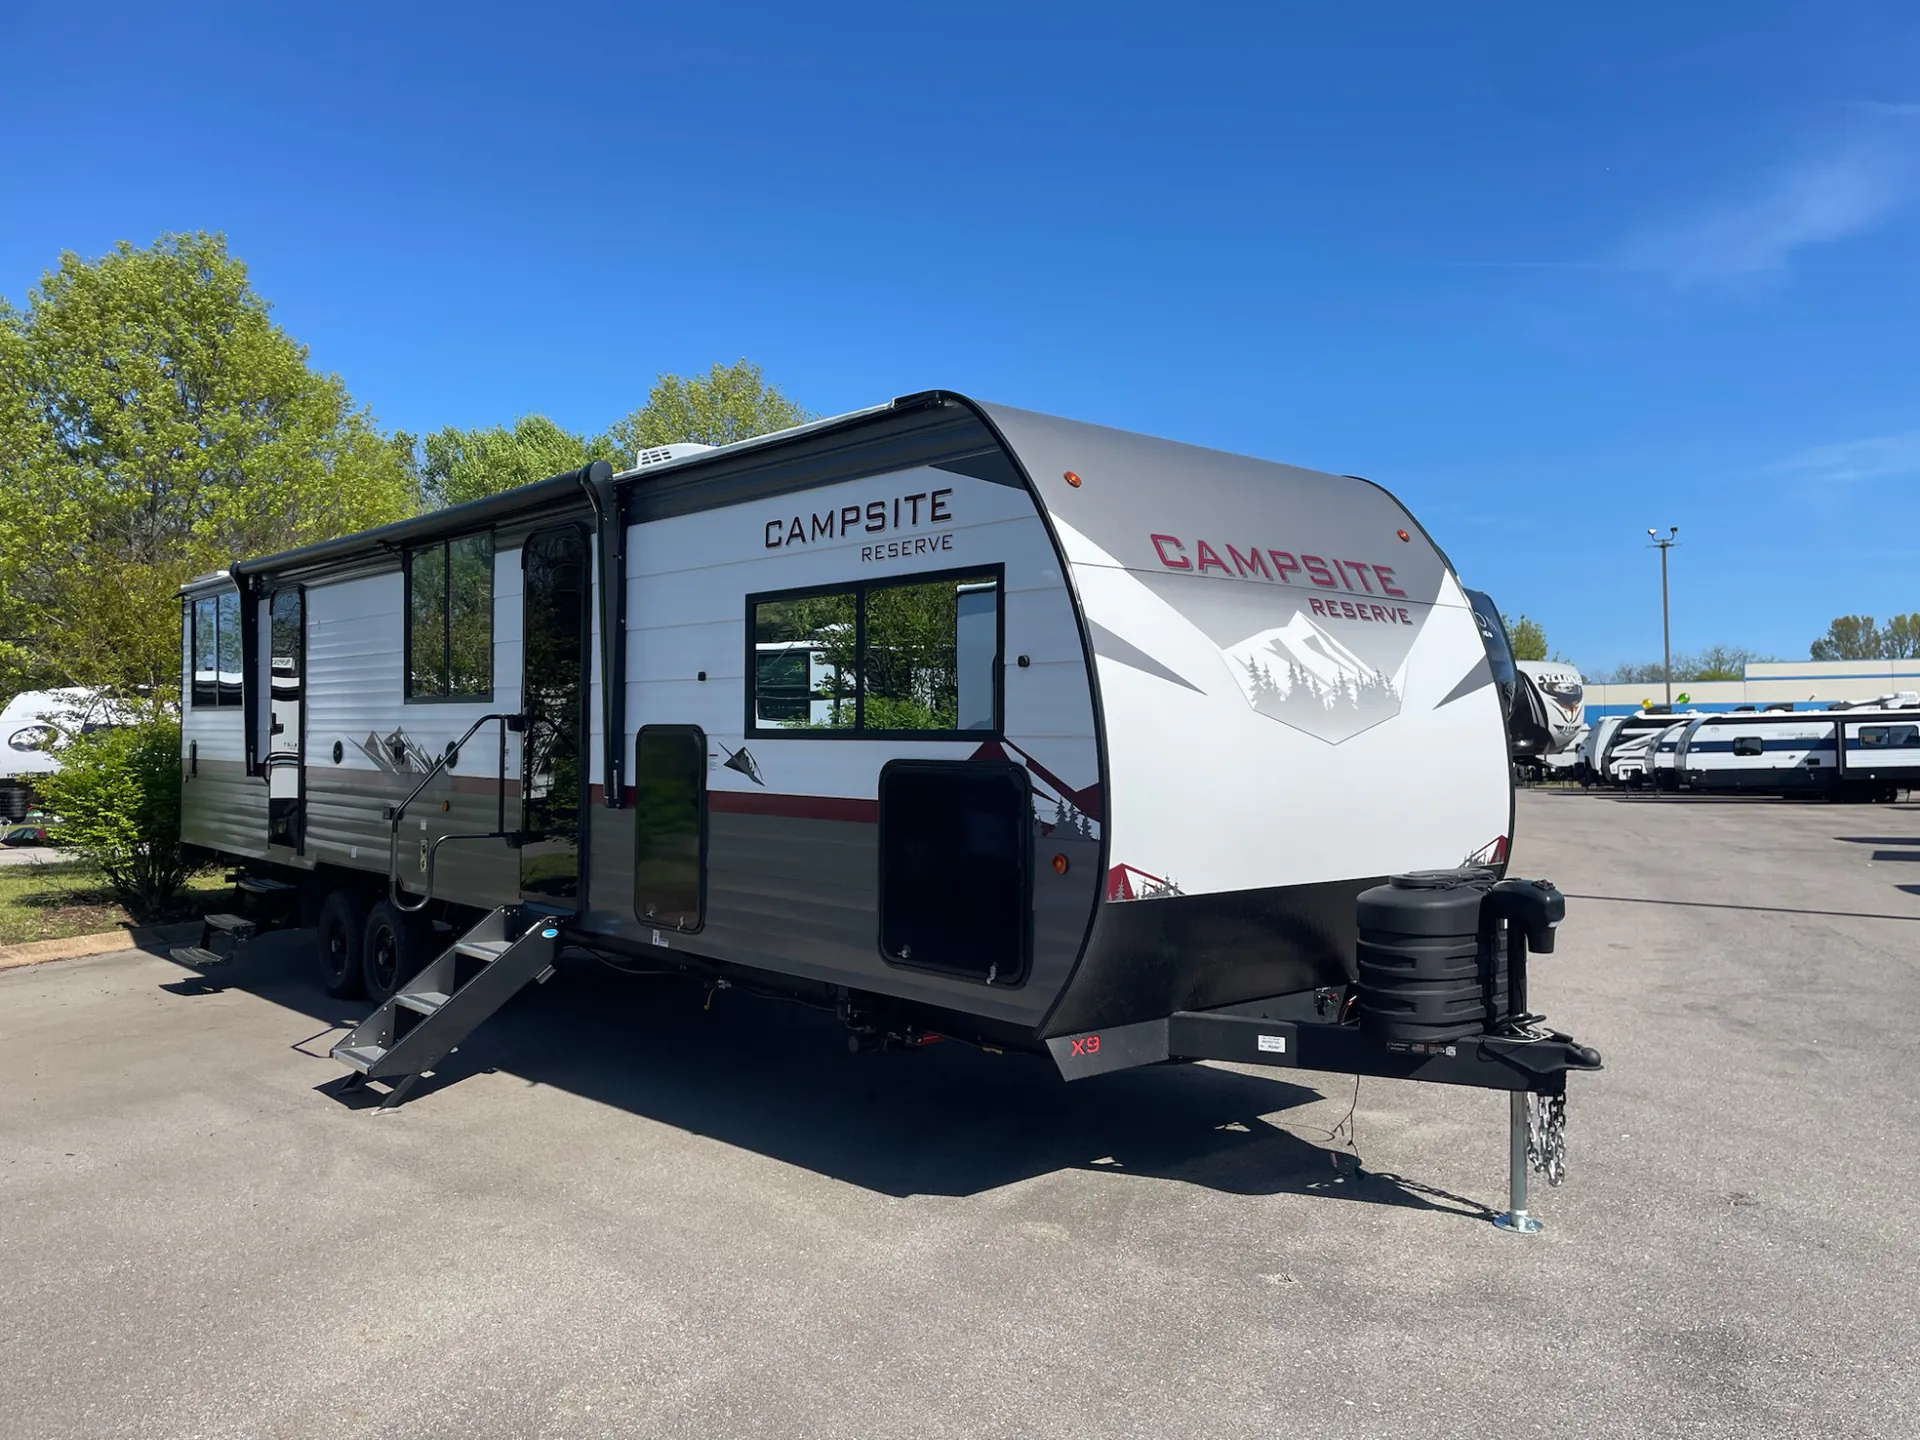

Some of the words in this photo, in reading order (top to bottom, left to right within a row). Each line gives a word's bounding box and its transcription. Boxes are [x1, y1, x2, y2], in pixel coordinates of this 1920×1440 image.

[765, 488, 952, 548] CAMPSITE
[861, 534, 953, 562] RESERVE
[1150, 533, 1408, 598] CAMPSITE
[1308, 597, 1413, 626] RESERVE
[1071, 1035, 1100, 1057] X9
